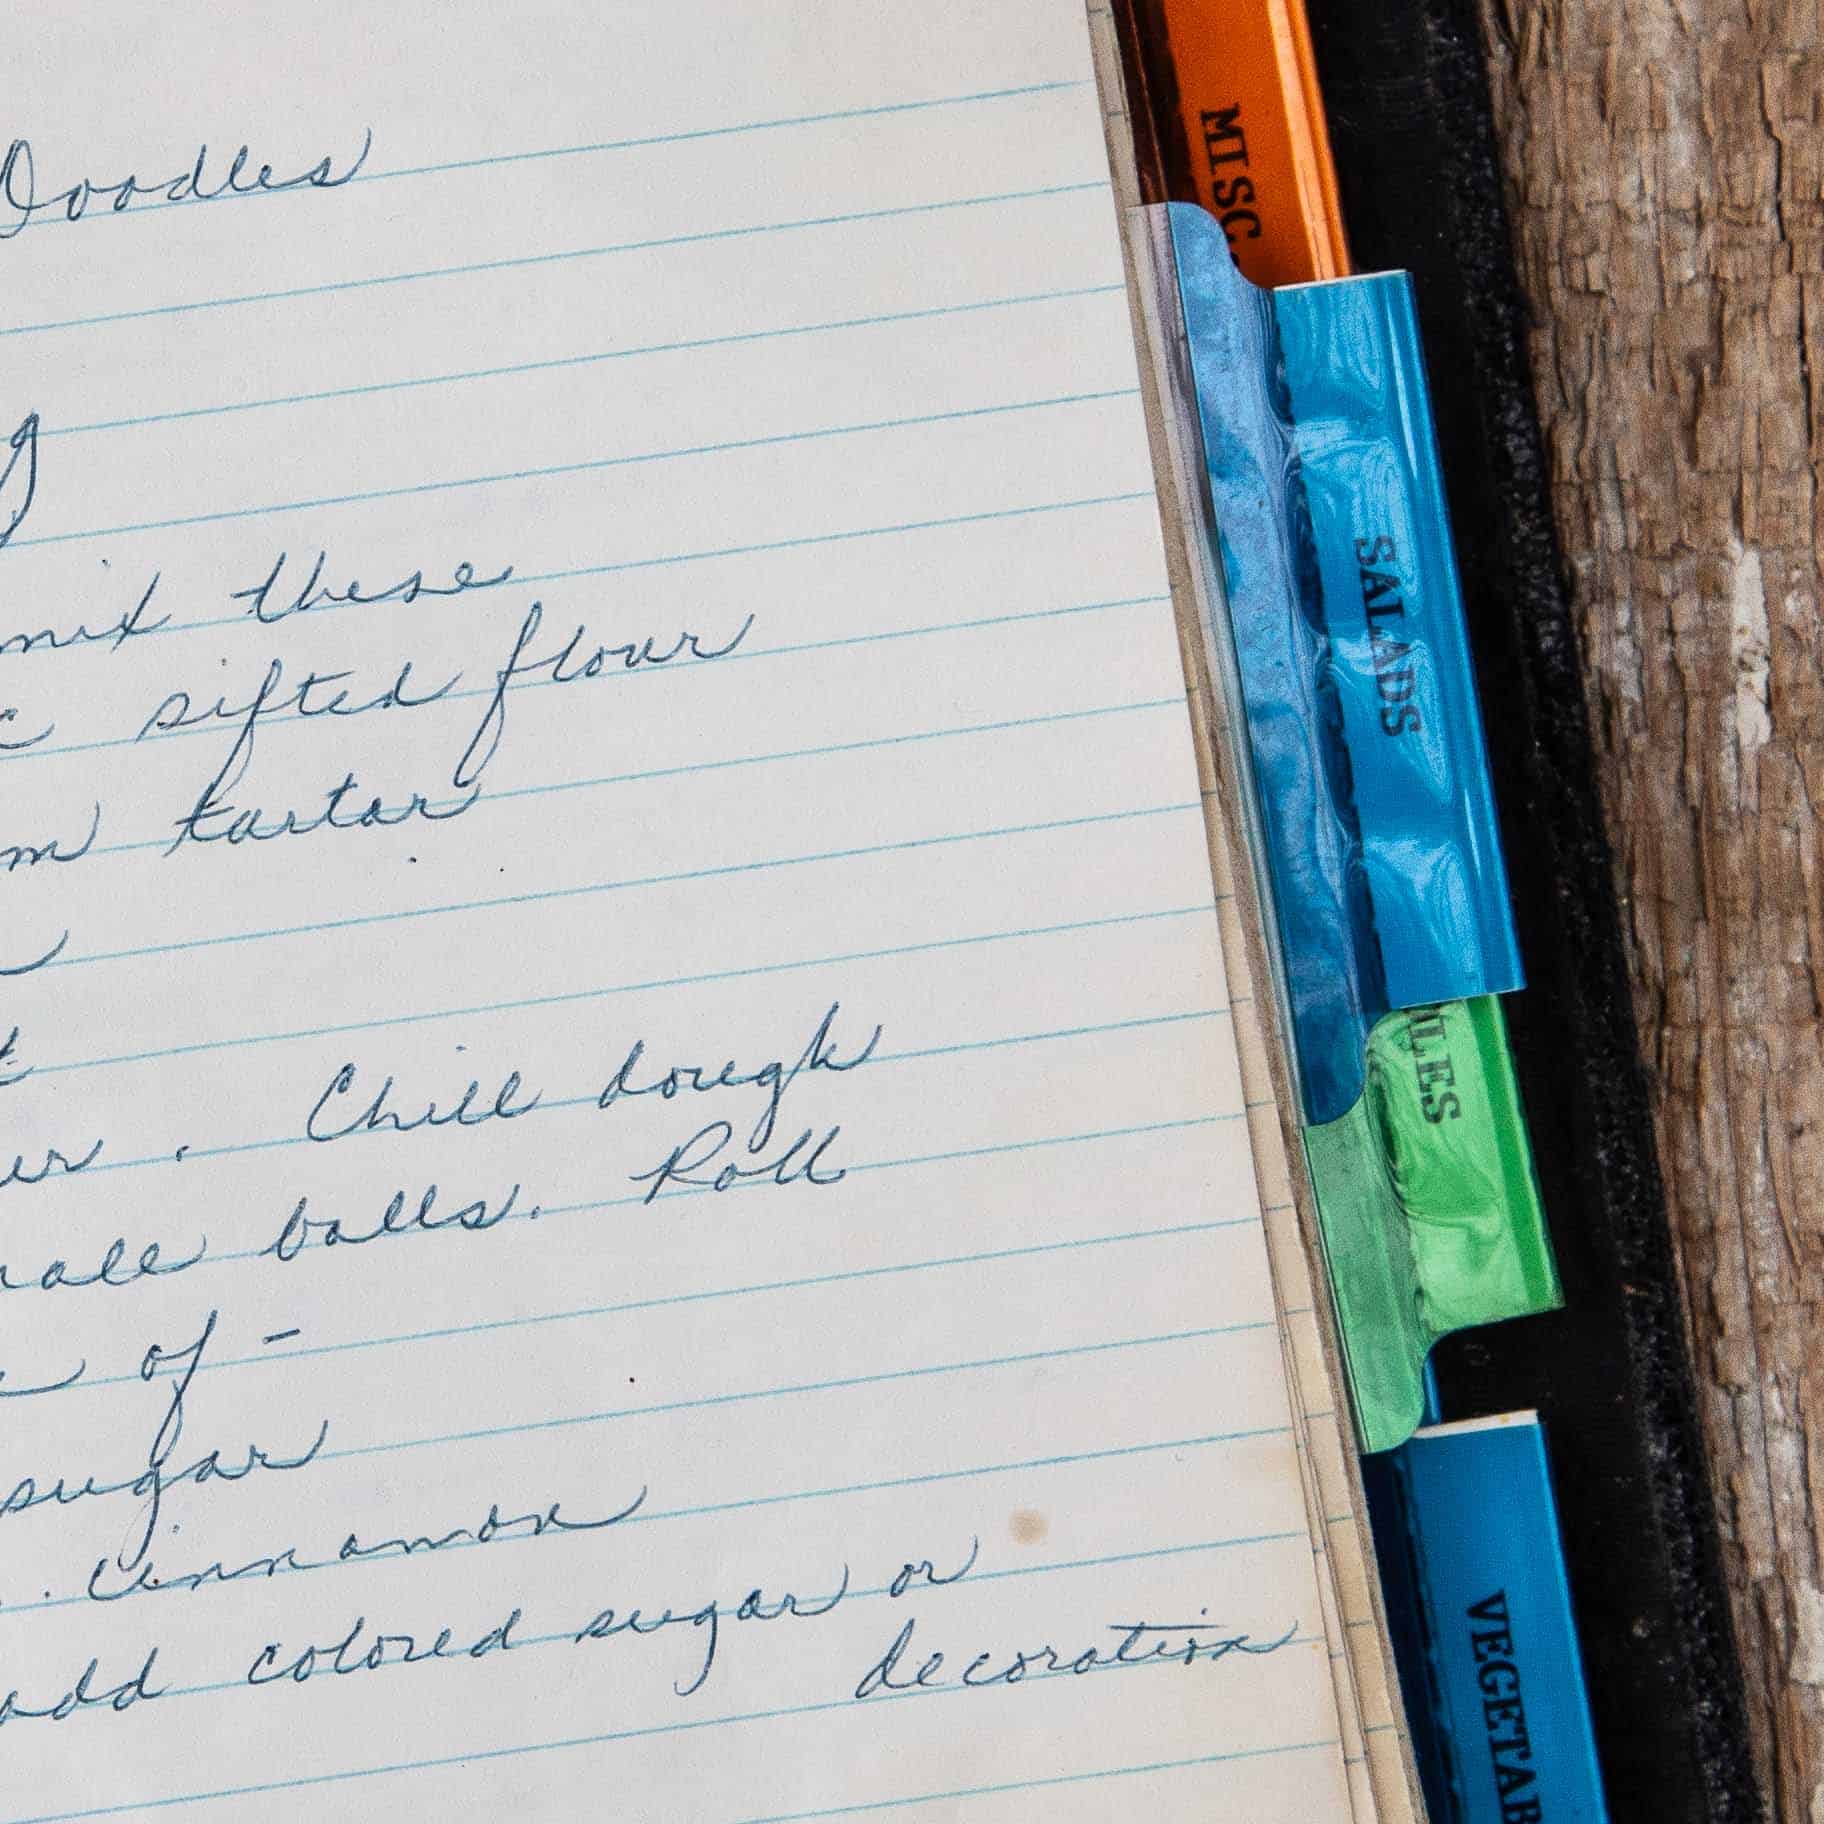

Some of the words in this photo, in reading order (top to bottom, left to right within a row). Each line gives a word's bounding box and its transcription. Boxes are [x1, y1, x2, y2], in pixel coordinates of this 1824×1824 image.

[231, 550, 514, 623] these
[1355, 534, 1422, 737] SALADS
[134, 658, 464, 808] sifted
[454, 600, 755, 788] flour
[163, 772, 481, 858] tartar
[306, 1044, 543, 1142] Chill
[598, 1001, 882, 1152] dough
[260, 1184, 540, 1262] balls.
[630, 1120, 846, 1204] Roll
[141, 1309, 217, 1466] of
[88, 1485, 647, 1601] cinnamon
[247, 1609, 522, 1685] colored
[575, 1563, 849, 1696] sugar
[889, 1536, 978, 1596] or
[854, 1608, 1299, 1698] decoration
